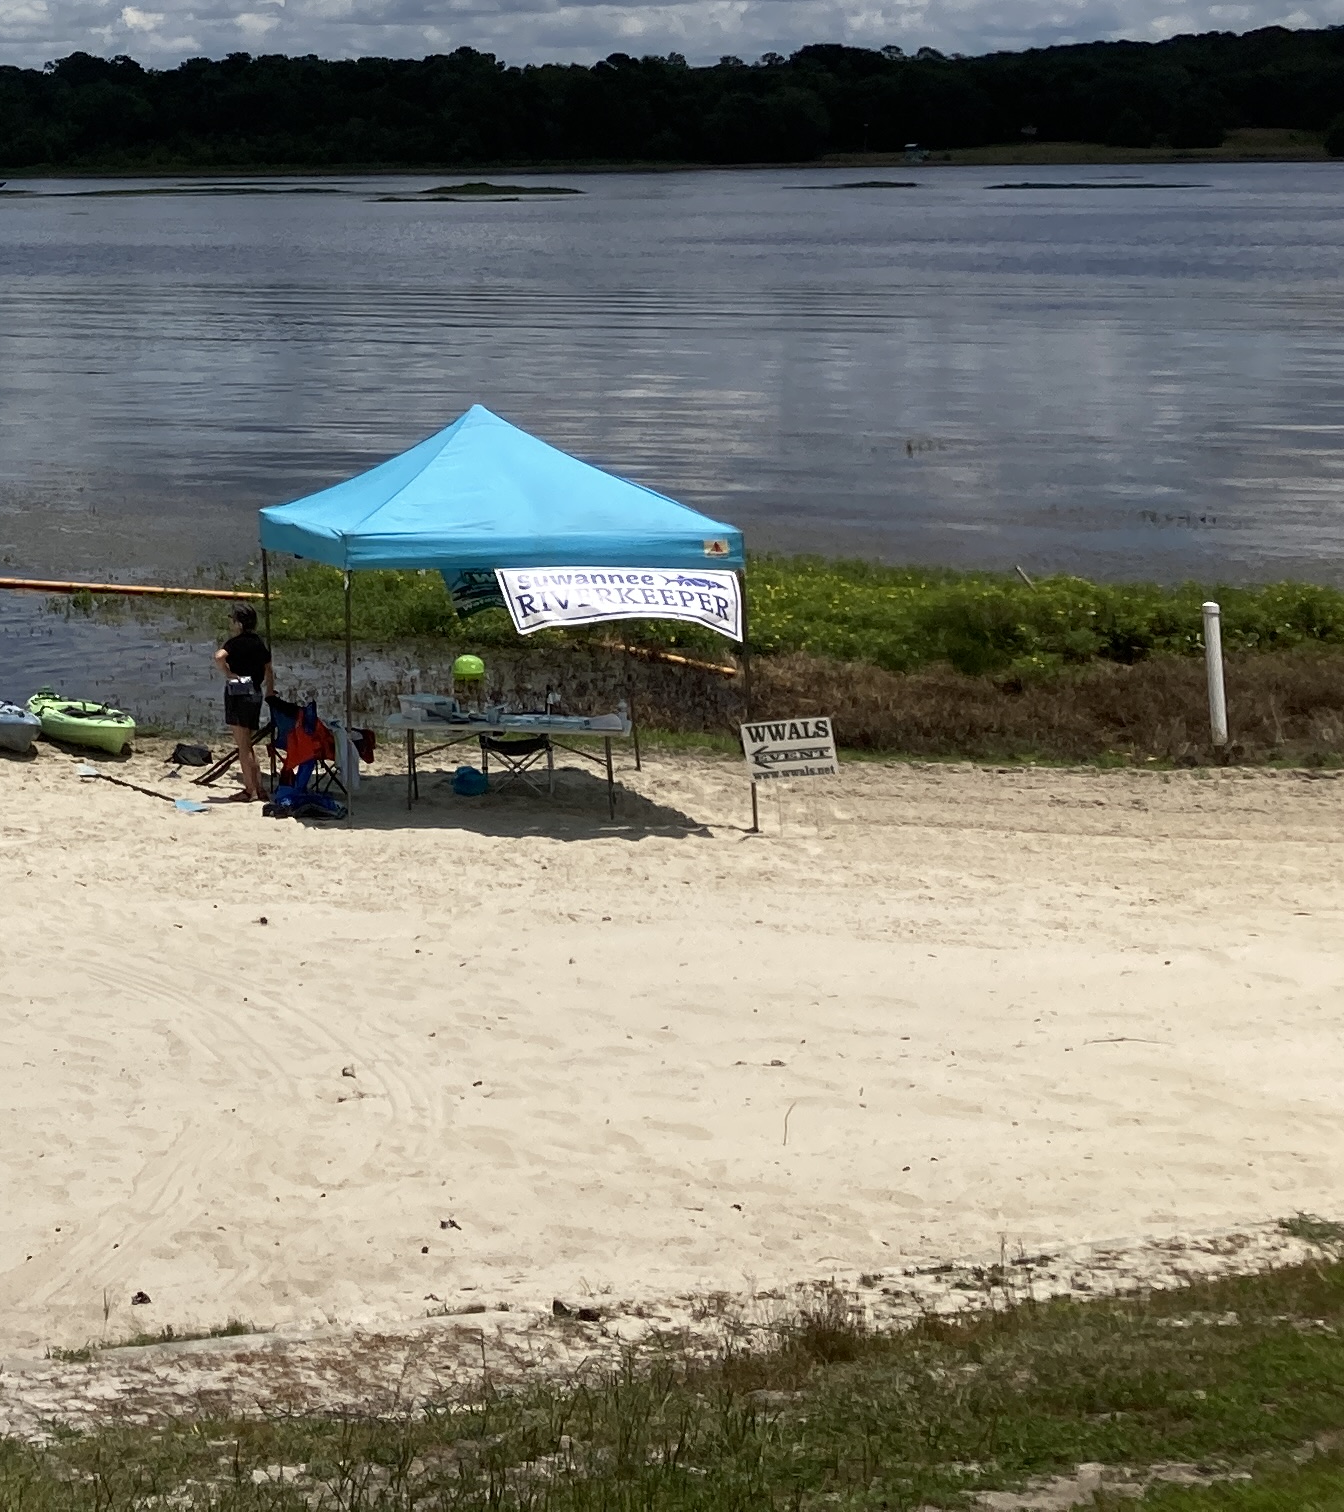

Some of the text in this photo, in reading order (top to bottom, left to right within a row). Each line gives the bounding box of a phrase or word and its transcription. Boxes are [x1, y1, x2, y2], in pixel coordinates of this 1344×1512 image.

[517, 573, 654, 590] Suwannee
[515, 588, 730, 621] RIVERKEEPER
[745, 720, 829, 743] WWALS
[754, 748, 830, 763] EVENT
[753, 765, 835, 779] www.wwals.net
